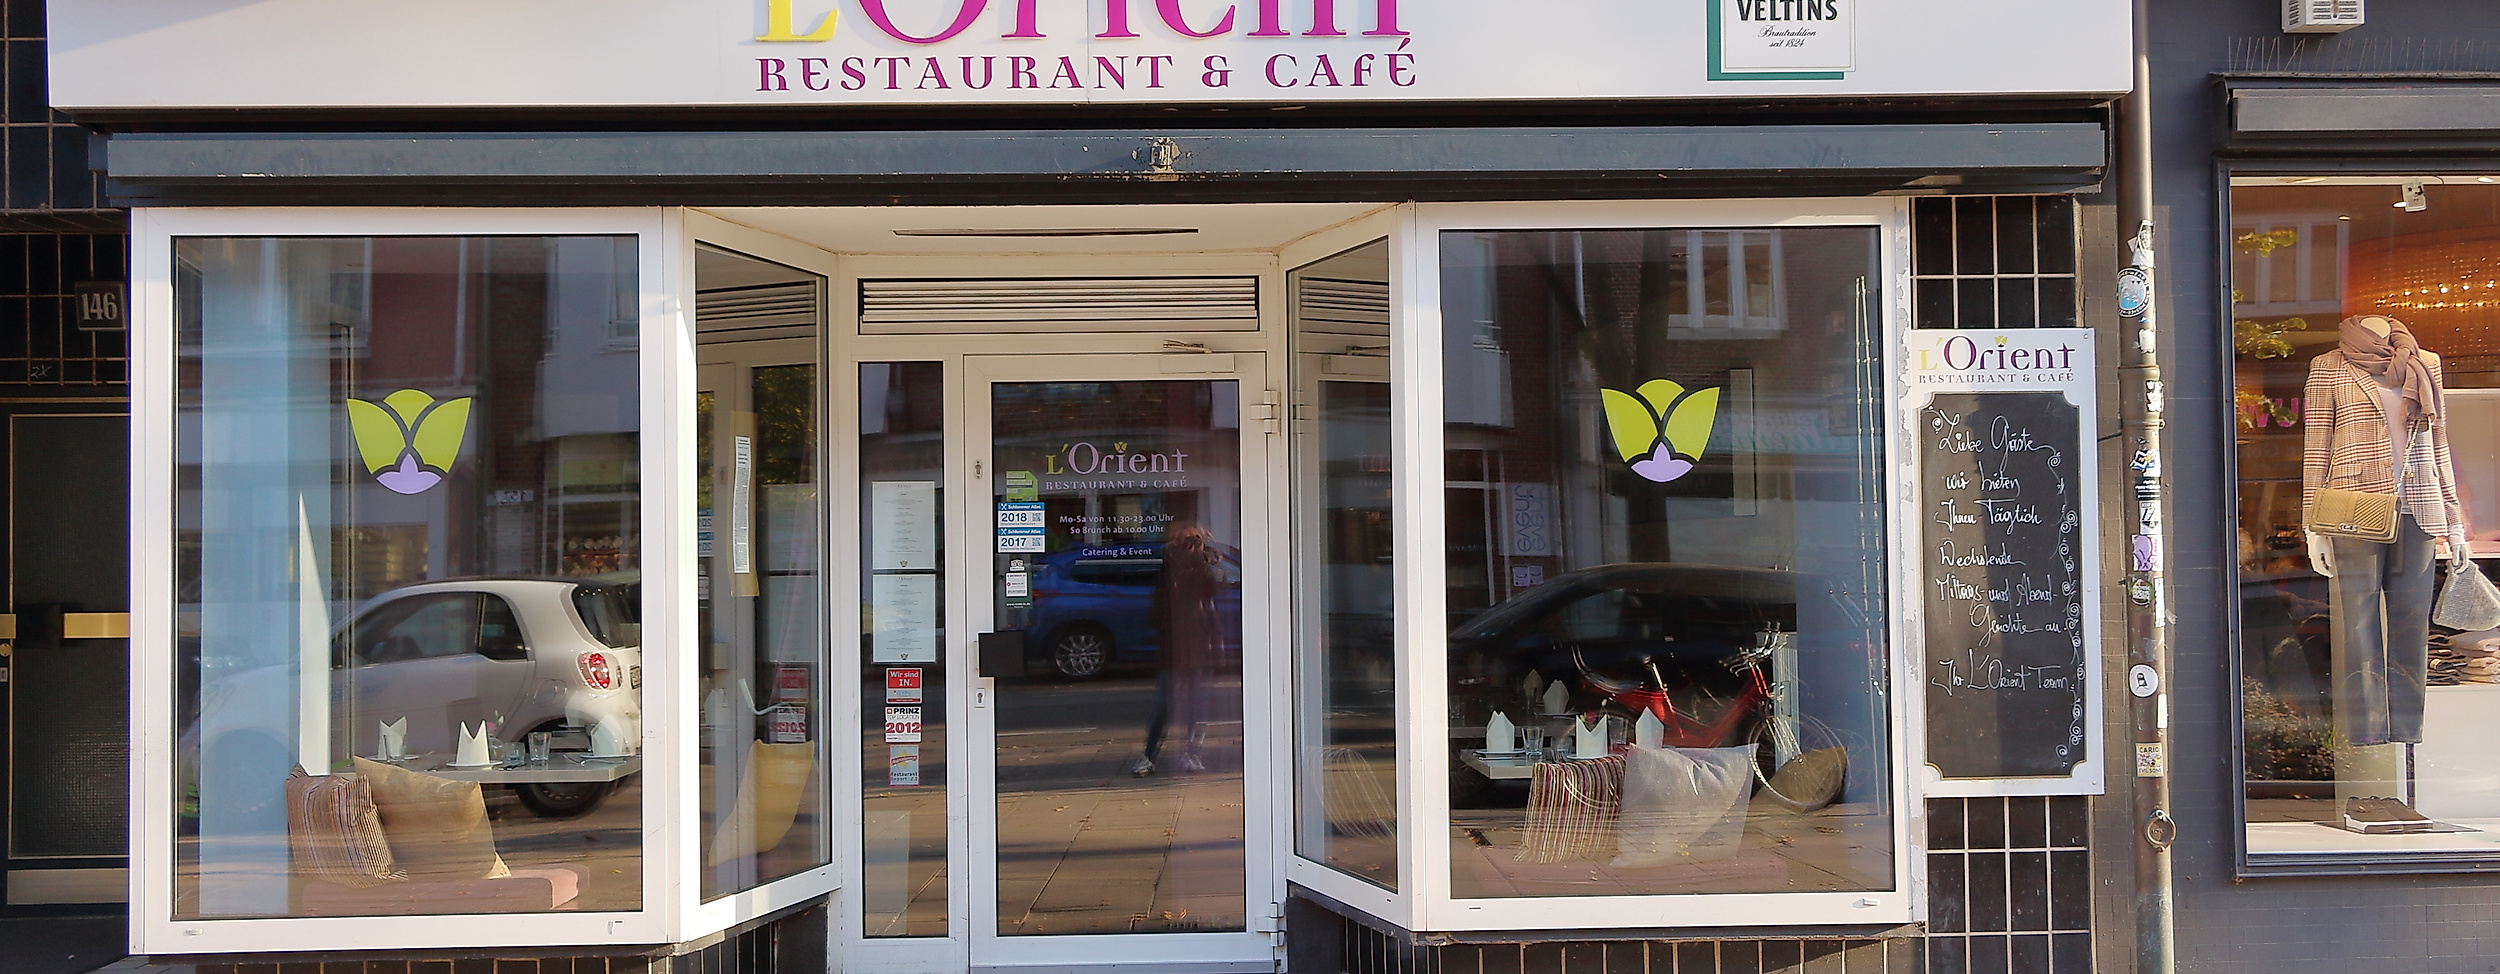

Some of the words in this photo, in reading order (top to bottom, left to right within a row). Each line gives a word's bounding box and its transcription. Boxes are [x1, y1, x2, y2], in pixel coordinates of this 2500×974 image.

[1736, 0, 1838, 21] VELTINS
[1758, 25, 1817, 37] Brautradition
[1769, 39, 1783, 48] seit
[1785, 39, 1805, 48] 1824
[755, 56, 1174, 91] RESTAURANT
[1201, 55, 1233, 88] &
[1265, 37, 1416, 88] CAFÉ
[82, 292, 119, 321] 146
[1918, 335, 2076, 371] L'Orient
[1918, 374, 2016, 384] RESTAURANT
[2022, 374, 2031, 383] &
[1938, 409, 1984, 454] Liebe
[1990, 415, 2036, 473] Gäste
[1045, 441, 1189, 475] L'Orient
[1045, 480, 1135, 490] RESTAURANT
[1140, 480, 1148, 489] &
[1945, 471, 1970, 490] wir
[1001, 512, 1028, 522] 2018
[1059, 515, 1087, 524] Mo-Sa
[1107, 515, 1157, 524] 11.30-23.00
[1158, 513, 1175, 522] Uhr
[1974, 498, 2042, 535] Täglich
[1070, 526, 1081, 535] So
[1082, 525, 1111, 534] Brunch
[1113, 525, 1123, 534] ab
[1149, 525, 1164, 533] Uhr
[1001, 537, 1027, 547] 2017
[1082, 547, 1118, 557] Catering
[1120, 547, 1127, 556] &
[1129, 547, 1152, 556] Event
[1988, 578, 2011, 604] und
[899, 679, 913, 687] IN.
[2028, 664, 2068, 691] Team
[885, 721, 921, 733] 2012
